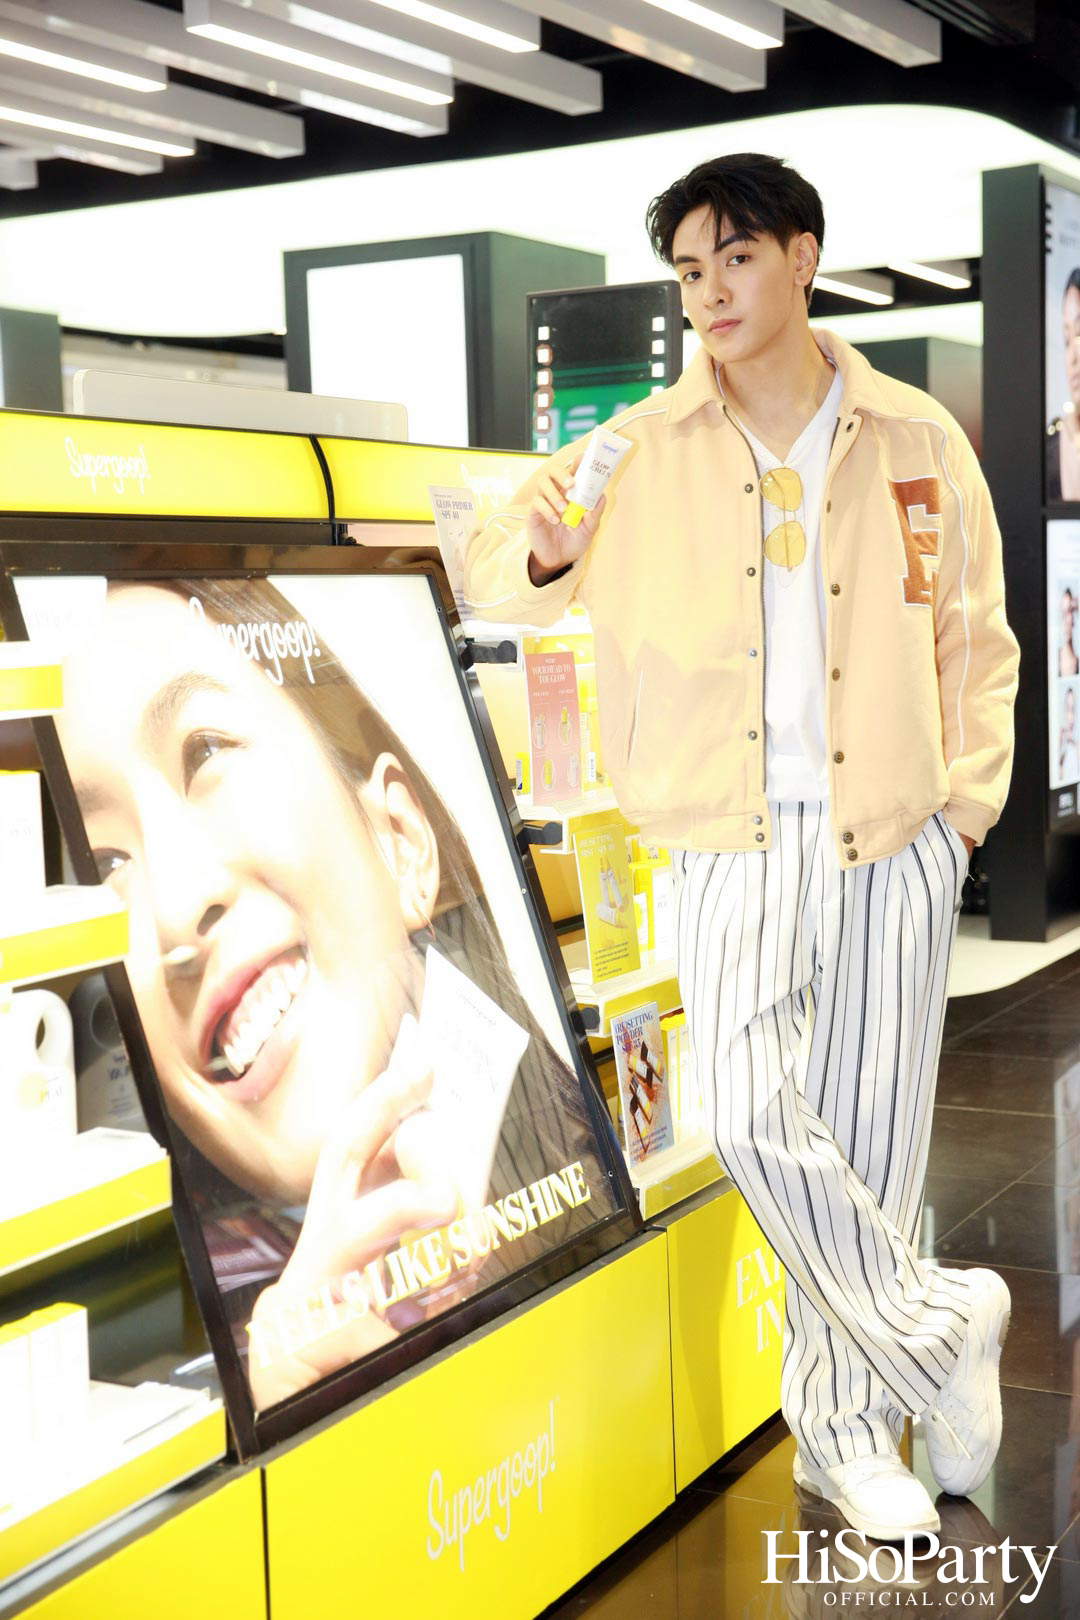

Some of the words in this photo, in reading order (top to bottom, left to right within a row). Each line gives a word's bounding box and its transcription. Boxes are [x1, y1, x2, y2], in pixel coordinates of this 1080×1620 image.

[64, 436, 152, 496] Supergoop!
[365, 1229, 452, 1310] LIKE
[448, 1160, 592, 1270] SUNSHINE
[426, 1399, 556, 1573] Supergoop!
